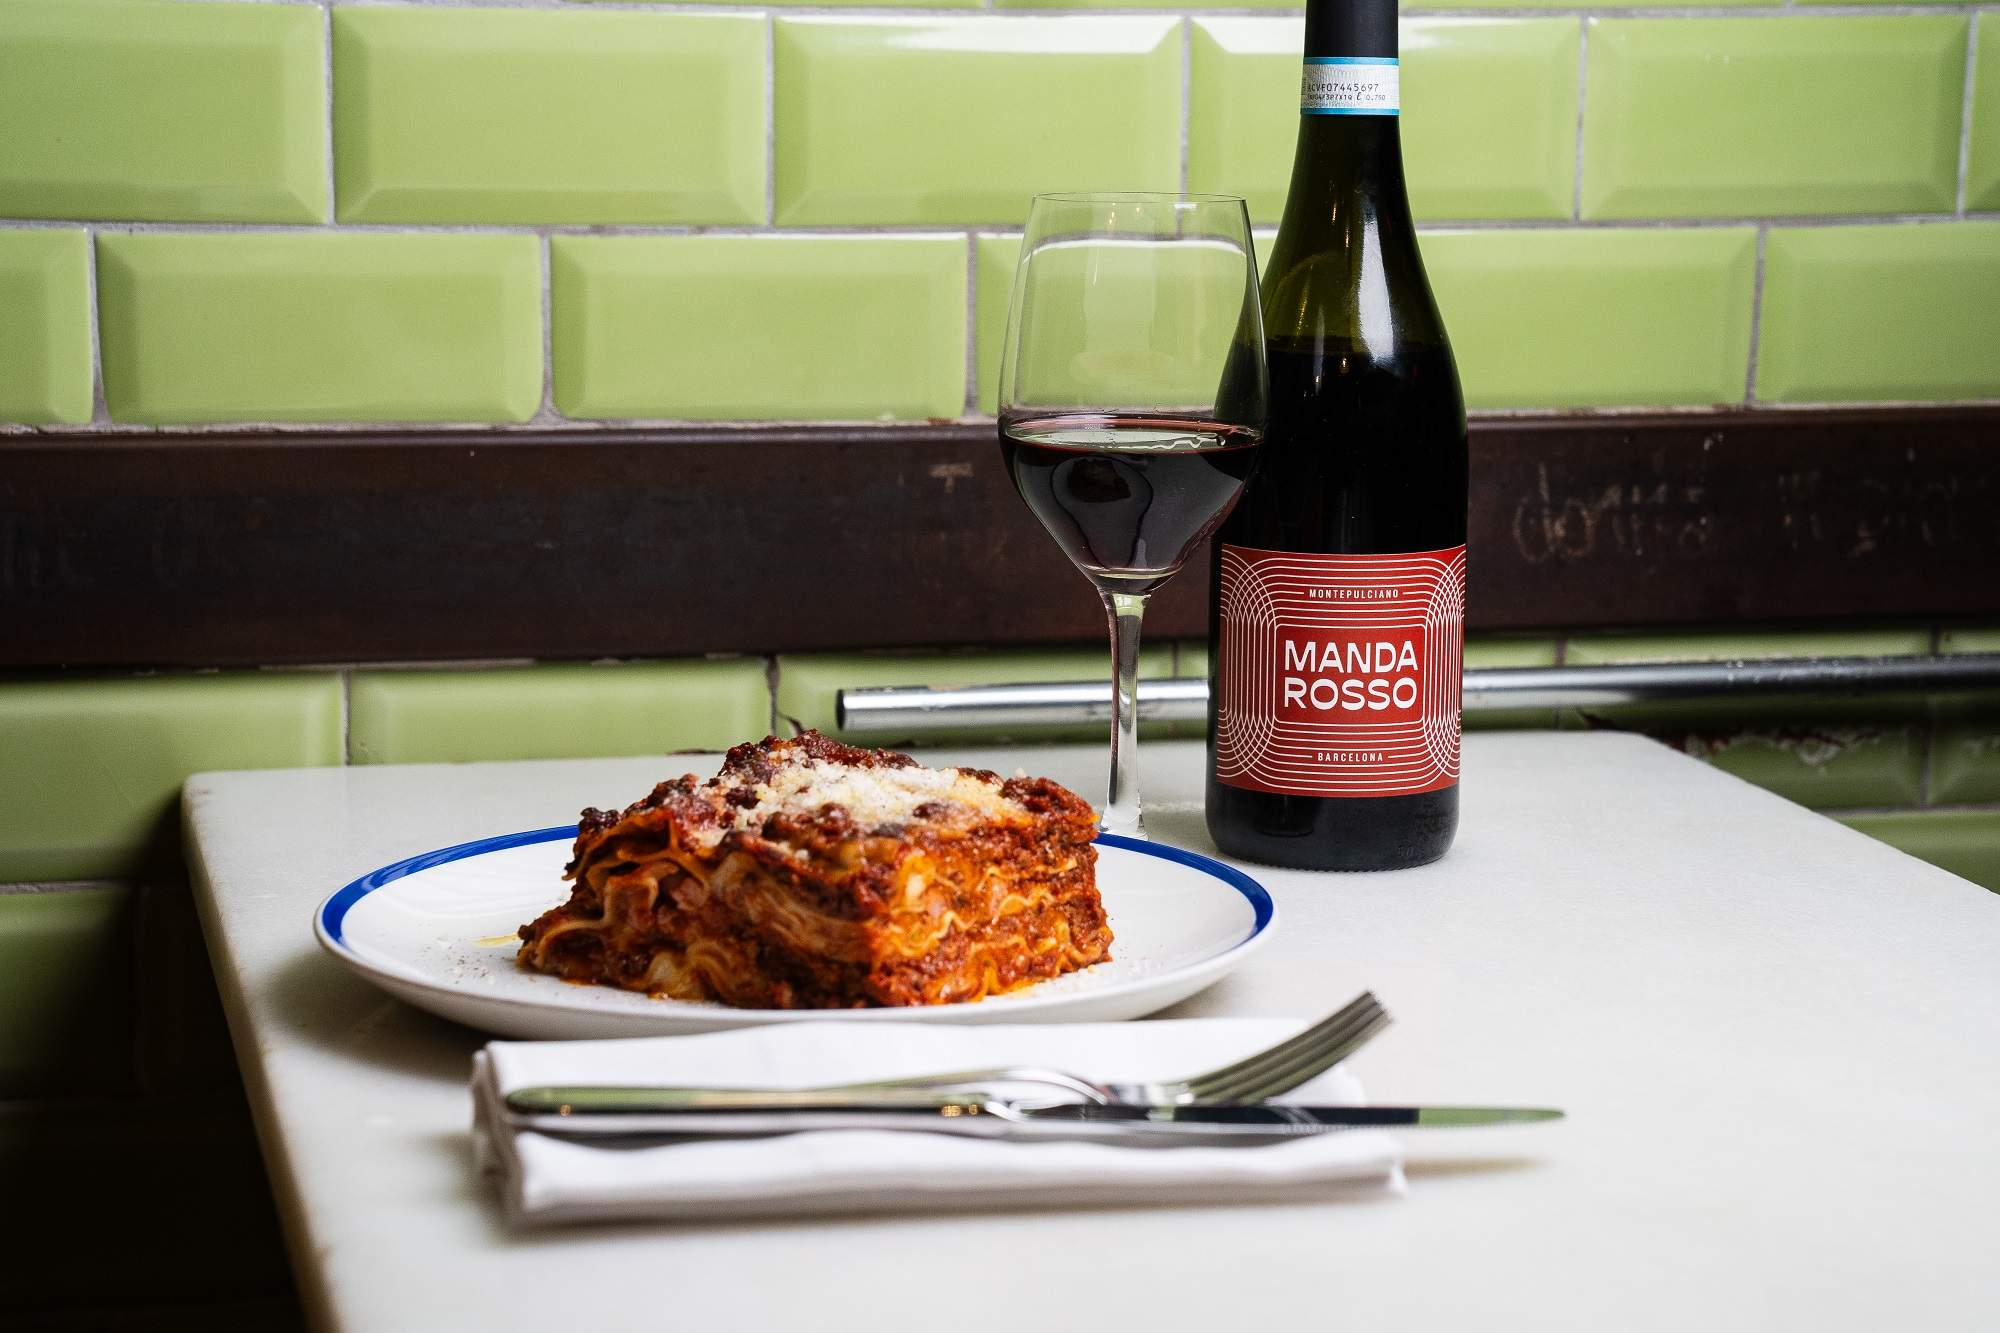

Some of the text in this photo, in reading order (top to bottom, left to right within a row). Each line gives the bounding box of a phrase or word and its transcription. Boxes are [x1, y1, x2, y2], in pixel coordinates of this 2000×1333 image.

[1309, 589, 1399, 600] MONTEPULCIANO
[1284, 639, 1419, 674] MANDA
[1284, 677, 1418, 711] ROSSO
[1317, 752, 1383, 762] BARCELONA
